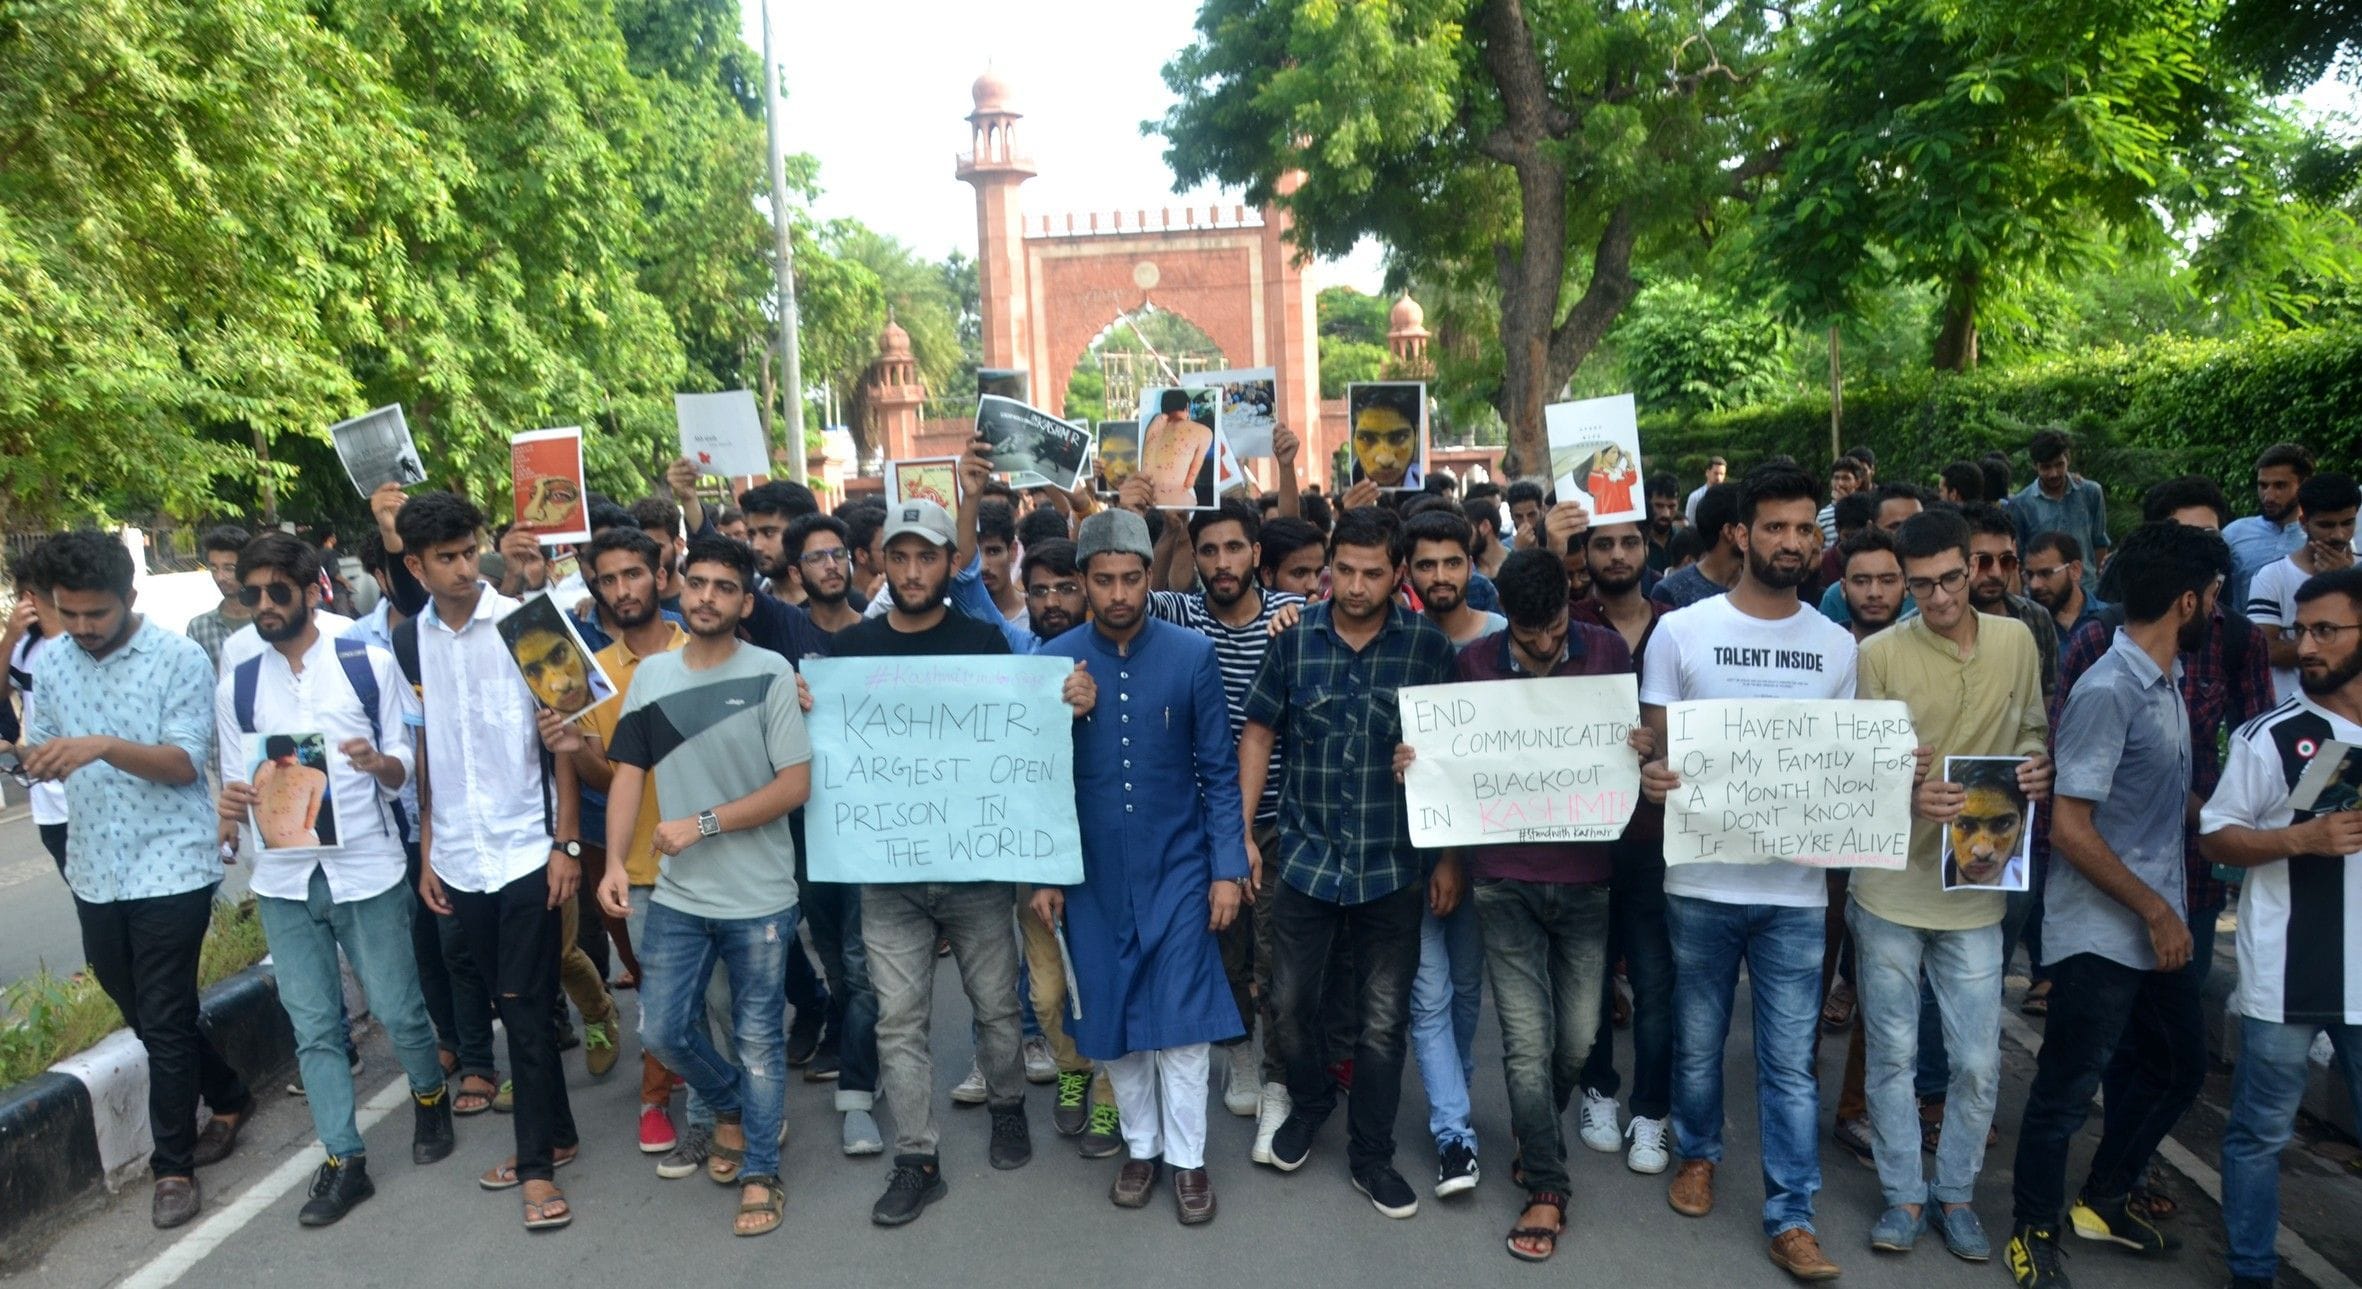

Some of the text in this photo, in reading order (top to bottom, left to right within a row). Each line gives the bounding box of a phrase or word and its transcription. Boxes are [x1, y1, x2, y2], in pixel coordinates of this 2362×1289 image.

[1713, 647, 1823, 673] TALENT INSIDE
[842, 693, 1040, 750] KASHMIR,
[1415, 699, 1476, 733] END
[1675, 707, 1911, 743] I HAVEN'T HEARD
[824, 753, 1054, 790] LARGEST OPEN
[1777, 747, 1855, 773] FAMILY
[1872, 747, 1912, 776] FOR
[1473, 764, 1605, 800] BLACKOUT
[1688, 784, 1706, 809] A
[1726, 780, 1809, 806] MONTH
[836, 794, 1006, 836] PRISON IN
[1419, 804, 1452, 830] IN
[1678, 800, 1875, 834] I DON'T KNOW
[876, 837, 932, 868] THE
[1694, 827, 1907, 859] IF THEY'RE ALIVE
